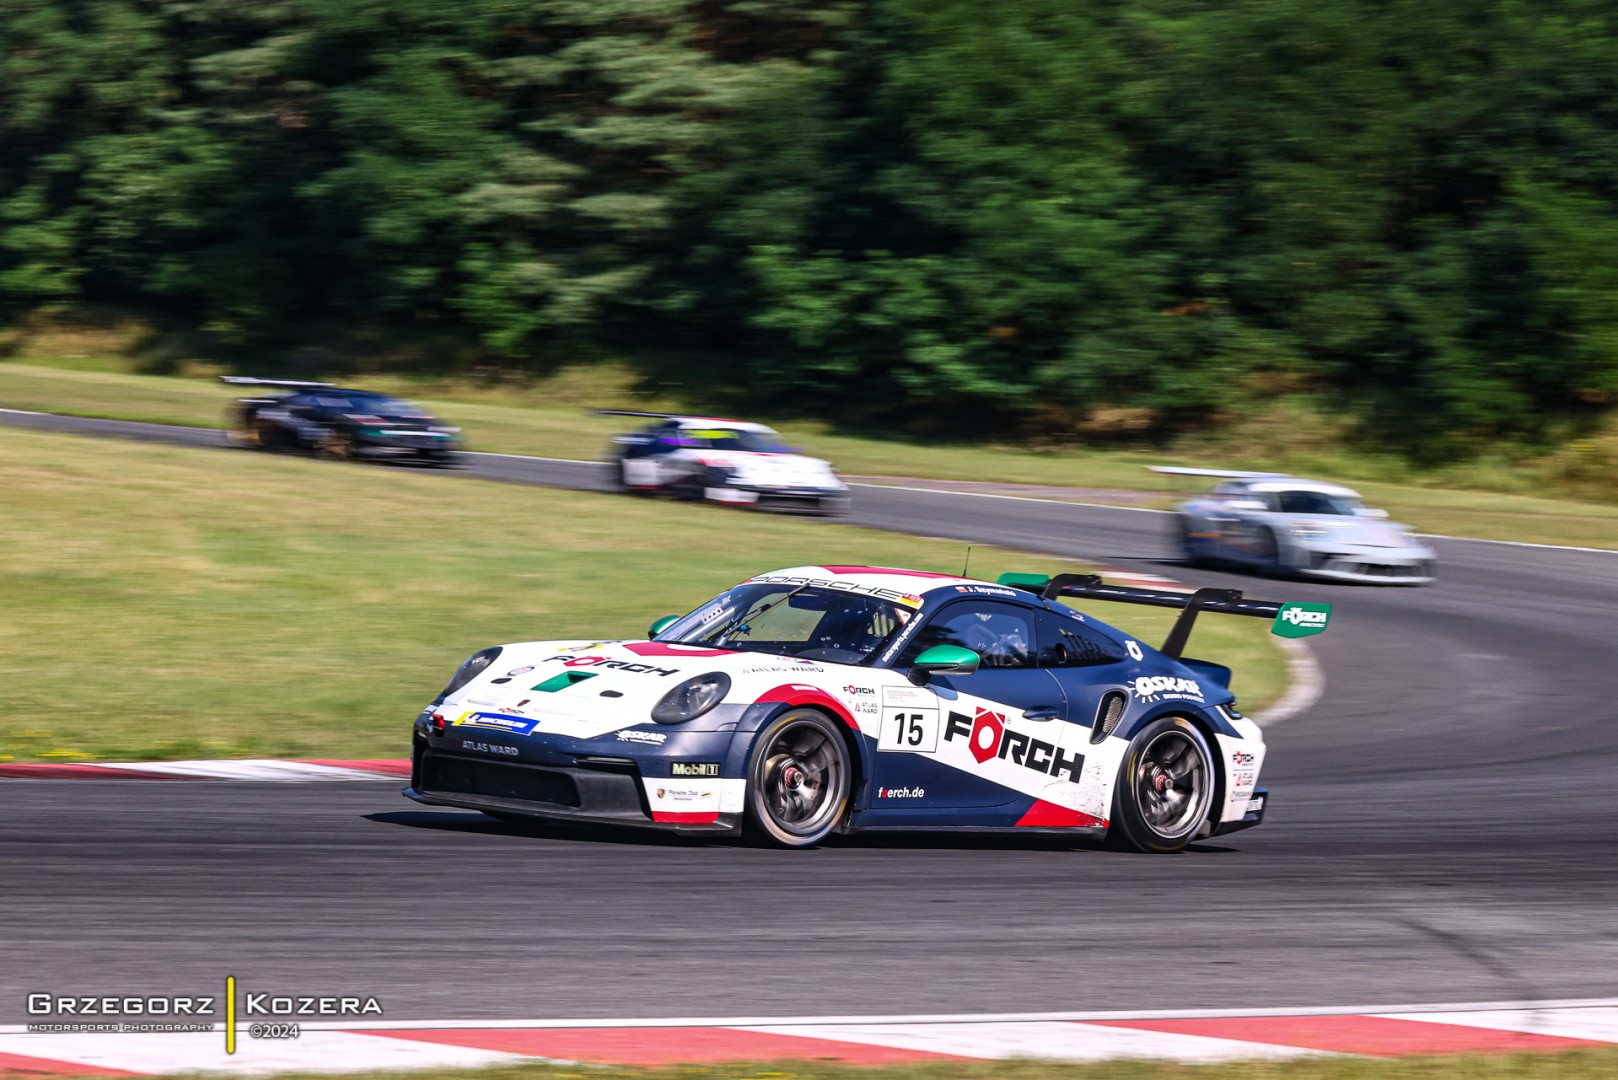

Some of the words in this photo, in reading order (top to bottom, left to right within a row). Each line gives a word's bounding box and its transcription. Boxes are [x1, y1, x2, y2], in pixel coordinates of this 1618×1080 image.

[751, 576, 904, 600] PORSCHE
[1135, 676, 1204, 697] OSKAR
[617, 730, 667, 744] OSKAR
[894, 712, 924, 746] 15
[462, 740, 488, 753] ATLAS
[489, 743, 519, 756] WARD
[944, 706, 1086, 784] FÖRCH
[672, 763, 706, 776] Mobil
[878, 786, 925, 799] foerch.de
